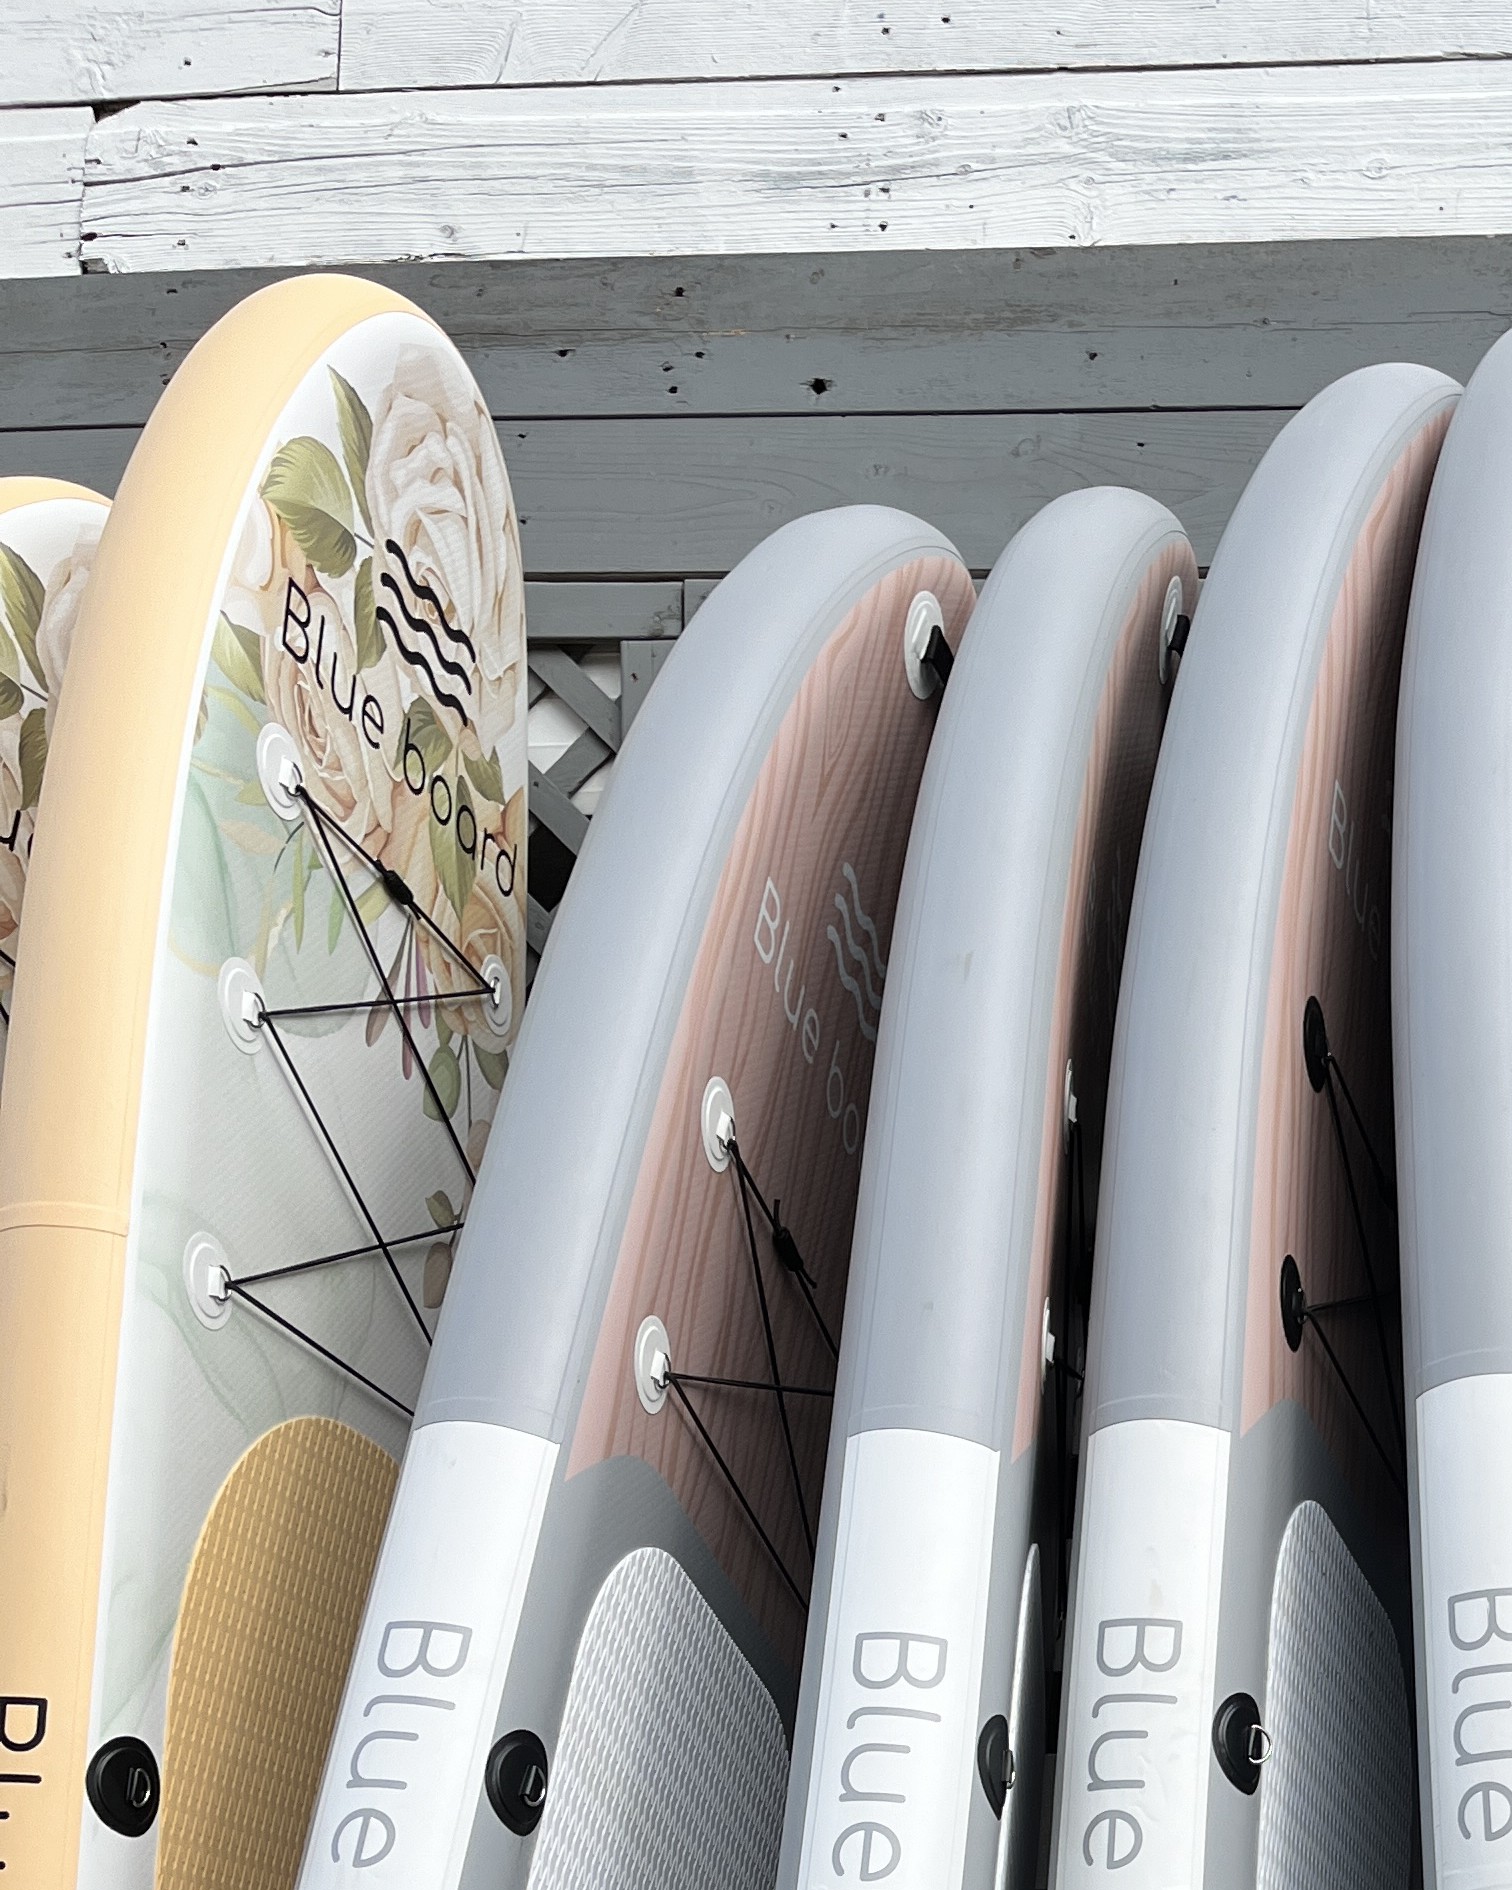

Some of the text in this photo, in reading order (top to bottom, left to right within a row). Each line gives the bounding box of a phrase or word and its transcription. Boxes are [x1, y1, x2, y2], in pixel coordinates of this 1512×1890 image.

[282, 577, 517, 896] Blue board
[754, 876, 820, 1064] Blue
[1329, 779, 1381, 962] Blue
[330, 1620, 473, 1869] Blue
[831, 1631, 949, 1882] Blue
[1082, 1617, 1184, 1871] Blue
